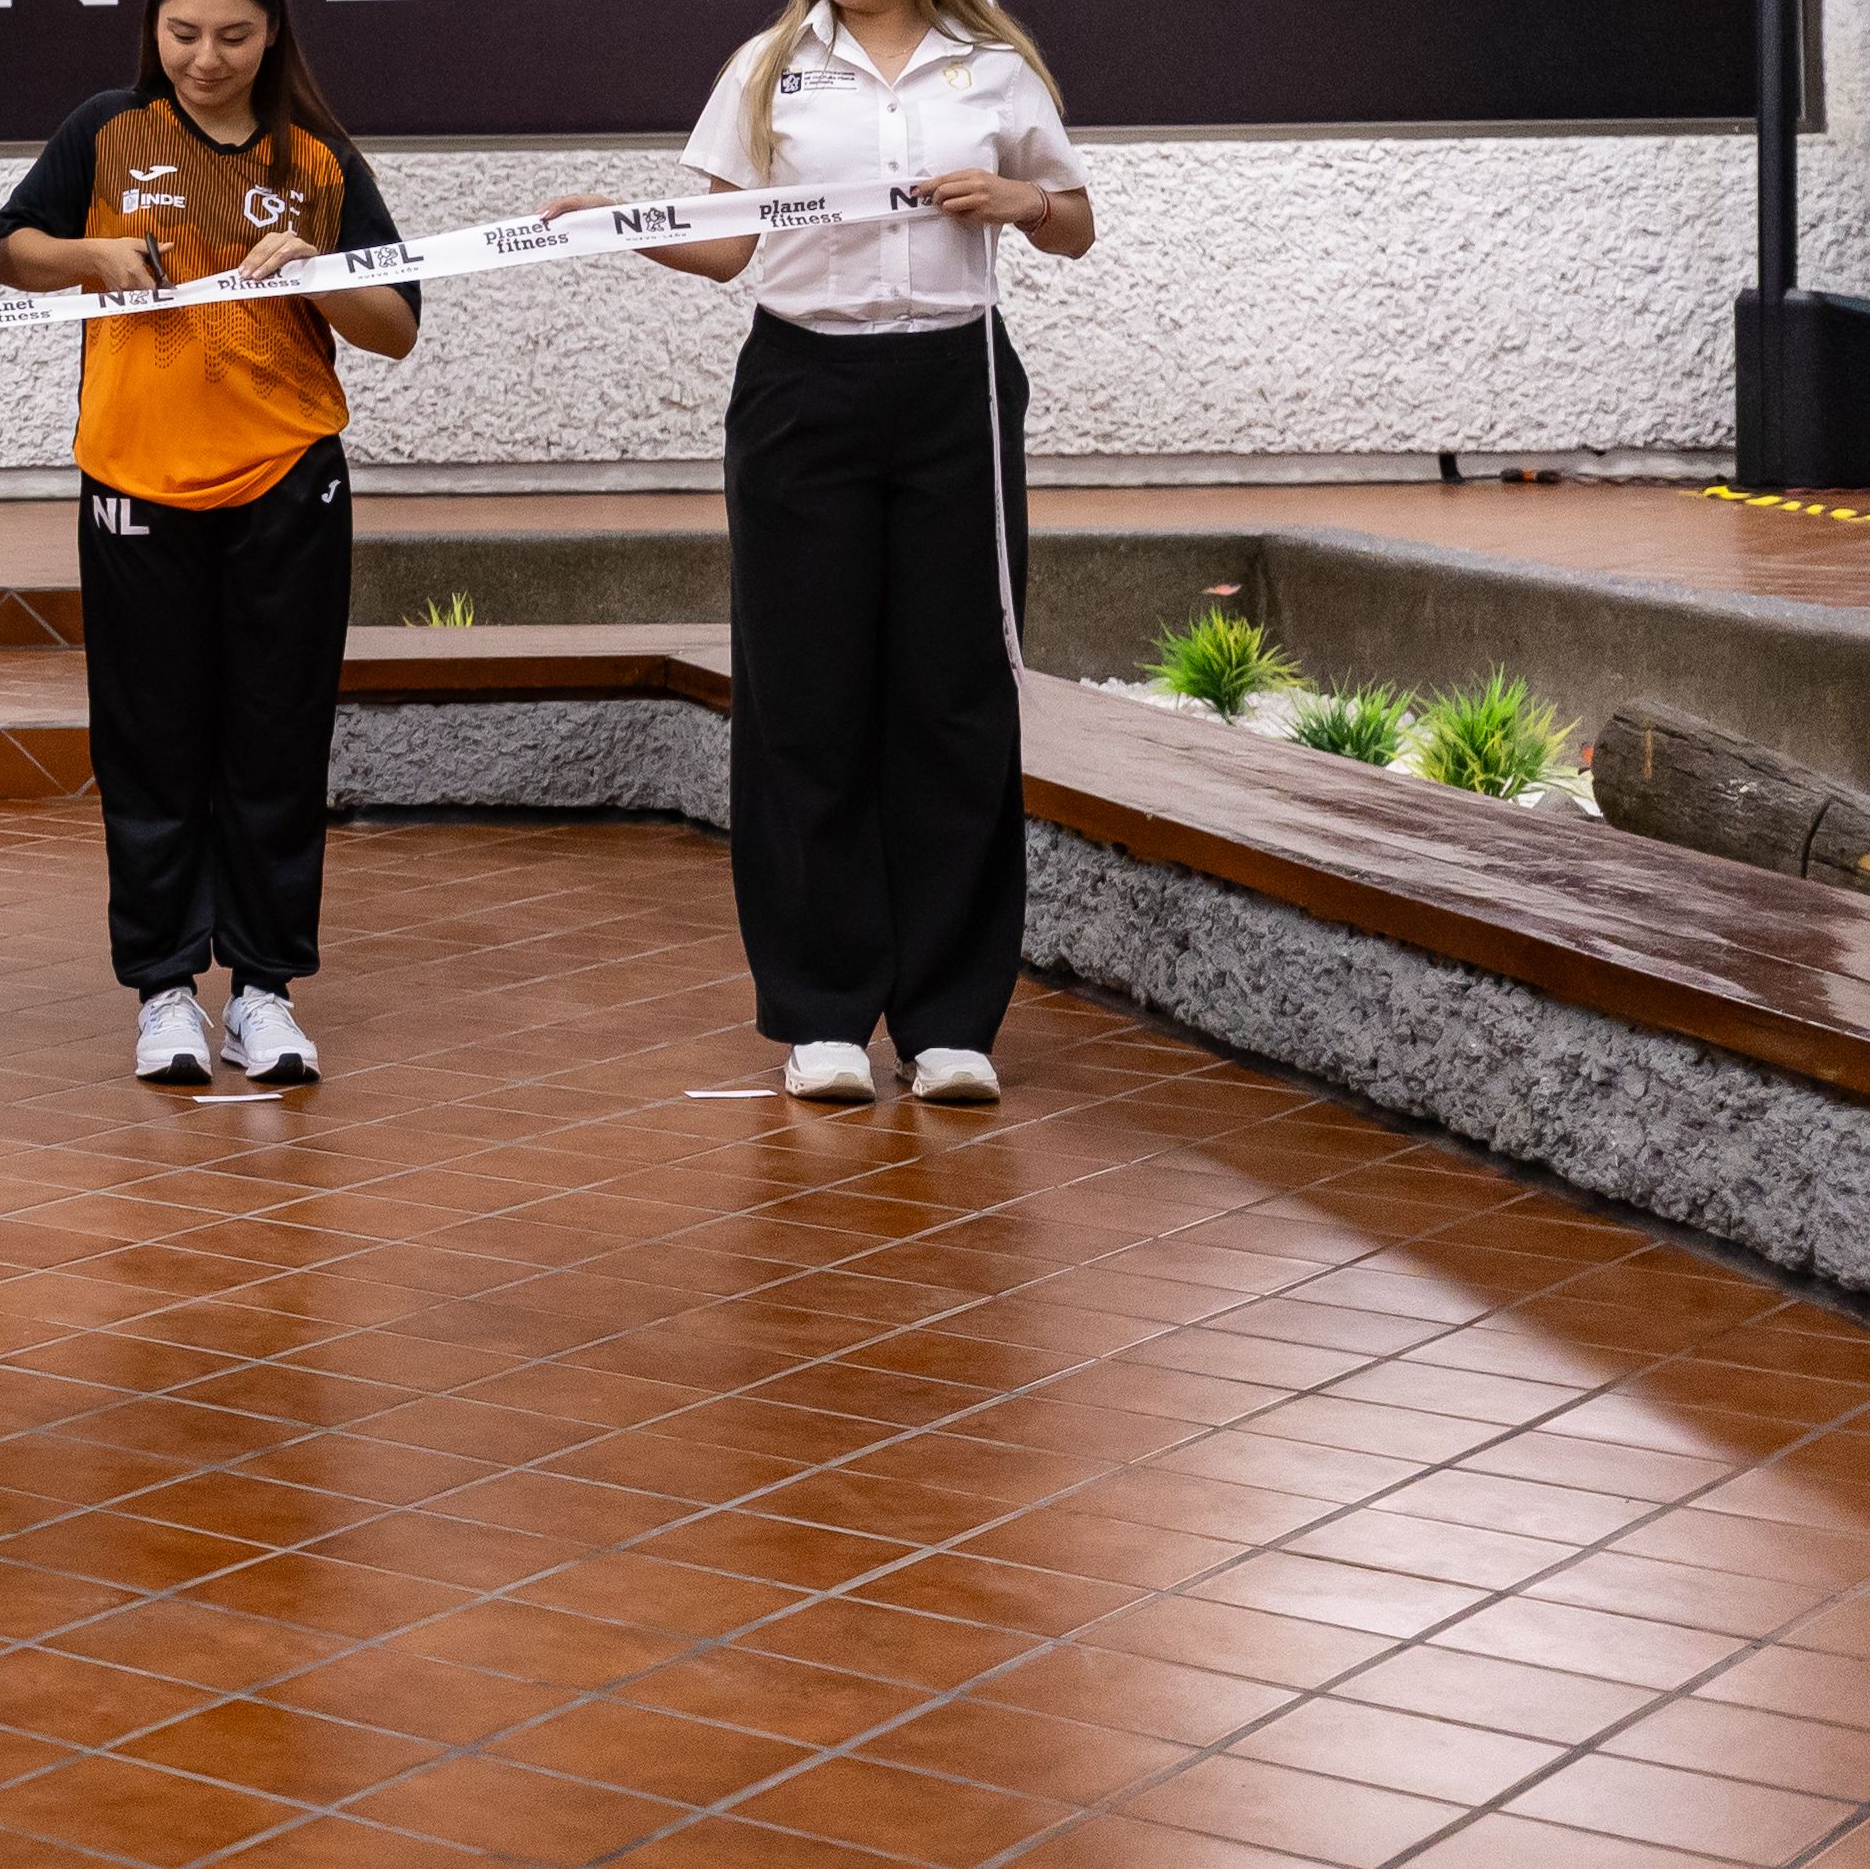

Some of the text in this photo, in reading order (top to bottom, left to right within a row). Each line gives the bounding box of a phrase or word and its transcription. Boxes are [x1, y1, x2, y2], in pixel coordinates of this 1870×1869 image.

[141, 193, 185, 209] INDE
[760, 185, 918, 219] planet N
[770, 212, 842, 228] fitness
[484, 221, 552, 245] planet
[497, 232, 569, 254] fitness
[92, 495, 151, 536] NL
